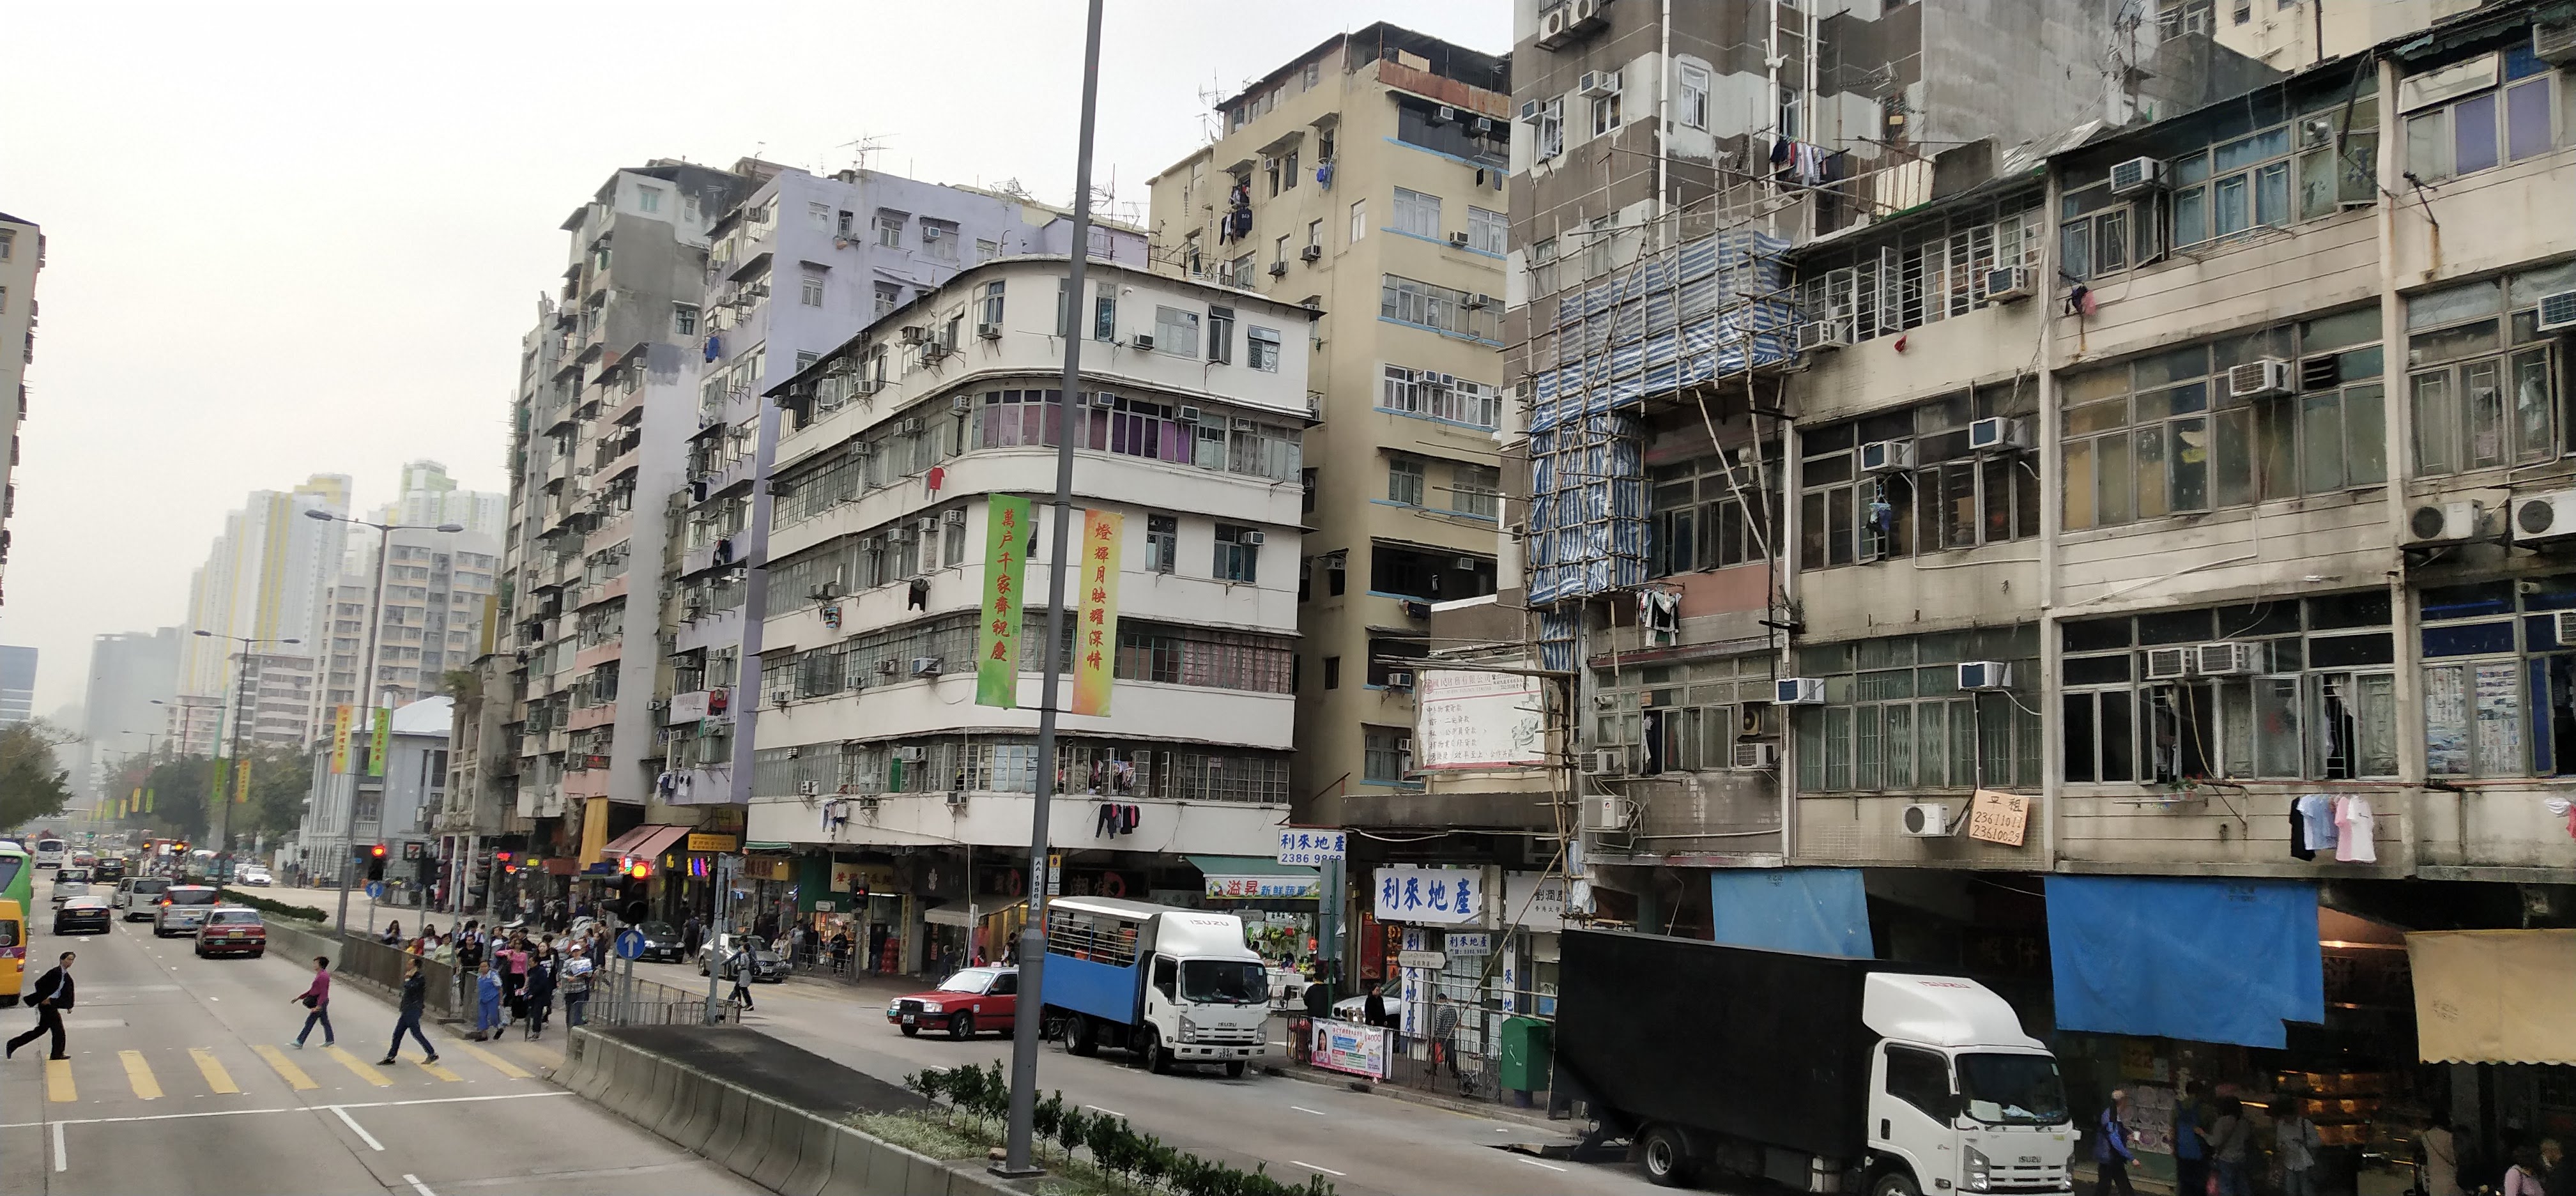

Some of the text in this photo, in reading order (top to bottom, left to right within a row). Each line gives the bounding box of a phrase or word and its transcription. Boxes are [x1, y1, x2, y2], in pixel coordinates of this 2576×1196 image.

[1974, 811, 2023, 828] 23611011
[1972, 824, 2020, 843] 23610029
[1280, 833, 1345, 852] 利來地產
[1281, 853, 1309, 863] 2386
[1226, 880, 1259, 896] 溢昇
[1382, 877, 1471, 914] 利來地產
[1449, 935, 1487, 947] 利來地產
